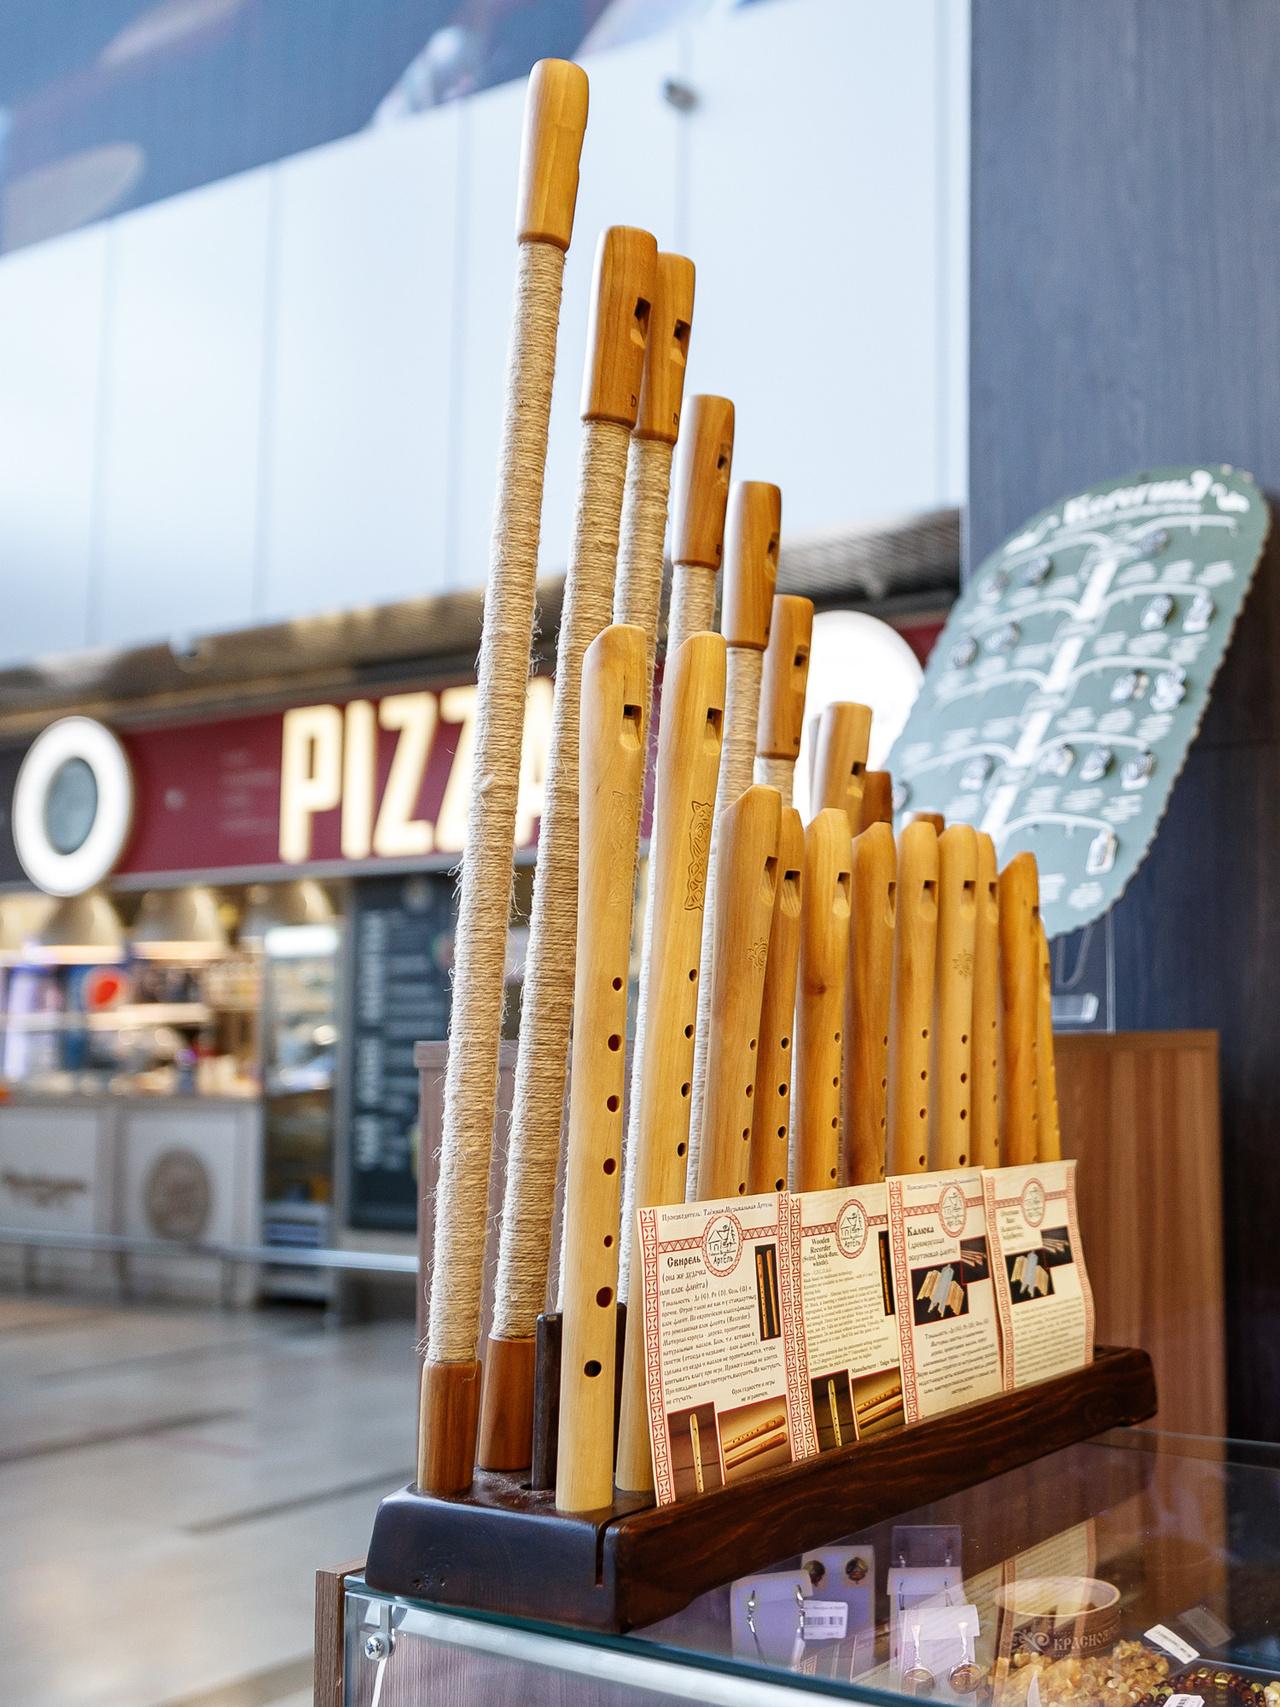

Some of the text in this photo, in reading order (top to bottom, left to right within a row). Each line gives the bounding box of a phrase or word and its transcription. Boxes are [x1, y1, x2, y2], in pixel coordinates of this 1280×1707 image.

[279, 676, 558, 864] PIZZA
[907, 1226, 934, 1236] Калюка
[810, 1245, 831, 1254] Recorder
[667, 1255, 701, 1268] Свирель
[686, 1269, 706, 1281] дудочка
[671, 1286, 684, 1294] блок
[686, 1279, 708, 1292] флейта)
[1054, 1629, 1111, 1651] КРАСНОЯ
